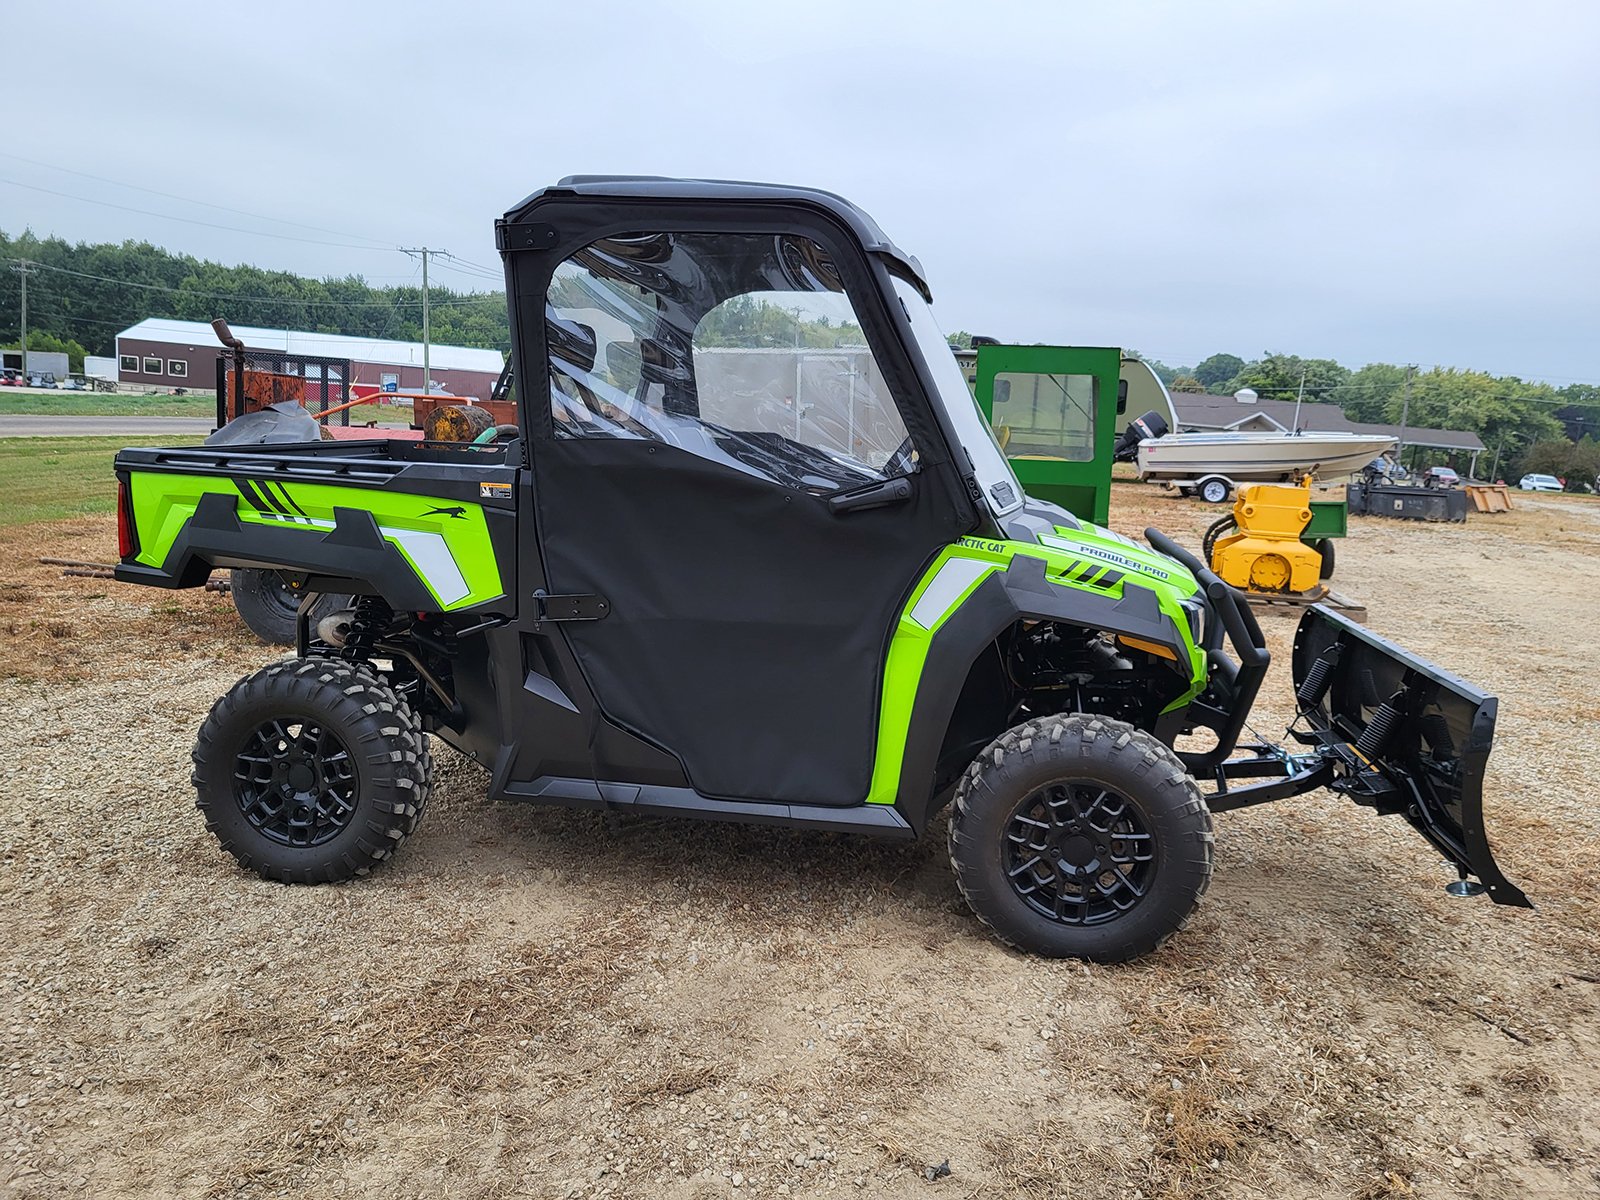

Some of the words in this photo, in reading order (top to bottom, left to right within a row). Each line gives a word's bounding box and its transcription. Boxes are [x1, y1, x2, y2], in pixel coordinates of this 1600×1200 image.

[987, 543, 1006, 553] CAT
[1080, 546, 1141, 570] PROWLER
[1144, 565, 1169, 579] PRO
